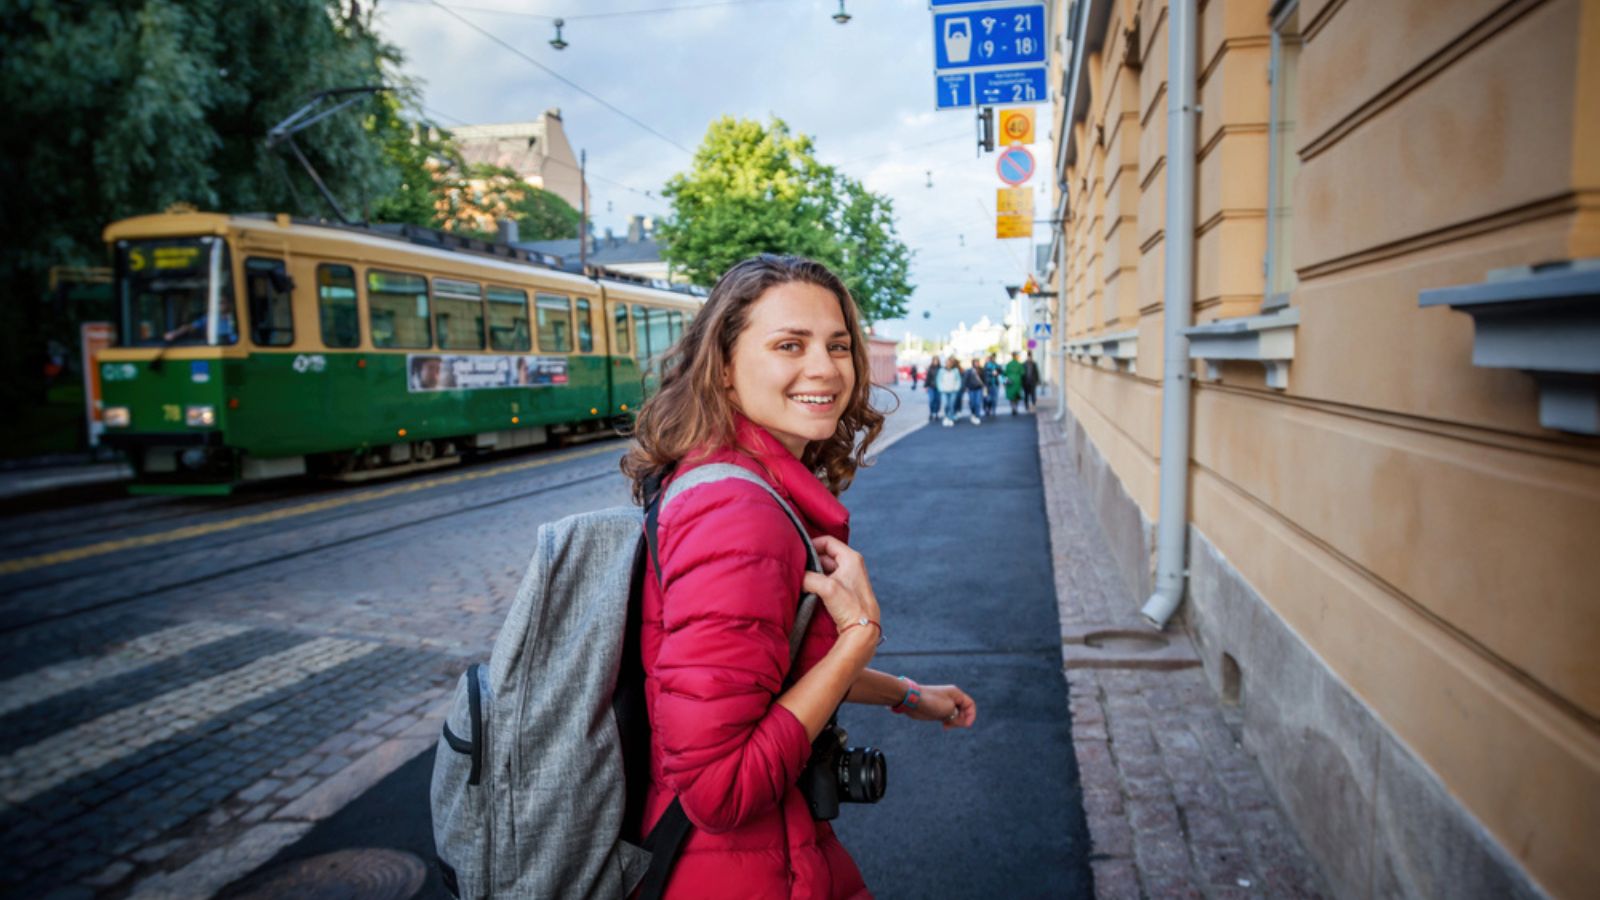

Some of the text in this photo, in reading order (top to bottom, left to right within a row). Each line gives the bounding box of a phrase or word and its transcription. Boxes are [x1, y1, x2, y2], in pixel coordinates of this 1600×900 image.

[981, 17, 996, 35] 9
[1014, 13, 1031, 32] 21
[978, 40, 994, 58] (9
[1015, 37, 1037, 56] 18)
[951, 88, 958, 105] 1
[1012, 84, 1023, 101] 2
[1025, 82, 1036, 101] h
